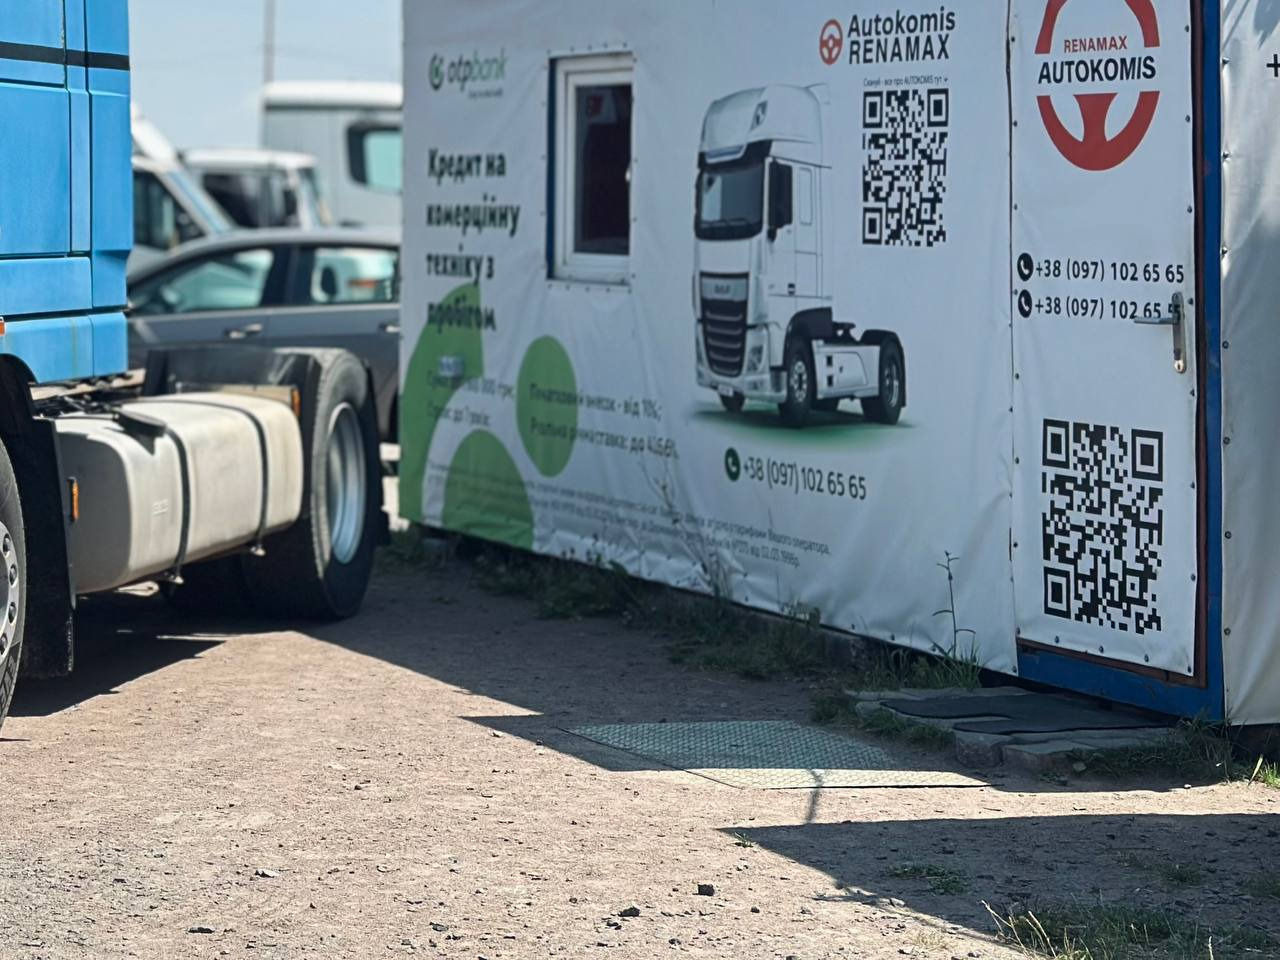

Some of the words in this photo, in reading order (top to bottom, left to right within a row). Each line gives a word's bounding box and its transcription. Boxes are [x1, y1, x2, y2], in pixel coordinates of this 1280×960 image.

[847, 5, 956, 38] Autokomis
[849, 34, 950, 64] RENAMAX
[1064, 35, 1127, 53] RENAMAX
[1038, 55, 1156, 84] AUTOKOMIS
[428, 148, 482, 186] Кредит
[486, 154, 506, 177] на
[426, 193, 521, 238] комерційну
[426, 243, 483, 286] техніку
[1035, 259, 1062, 278] +38
[1066, 258, 1105, 282] (097)
[1111, 262, 1138, 281] 102
[1143, 264, 1160, 283] 65
[1165, 264, 1184, 283] 65
[1035, 296, 1062, 315] +38
[1066, 296, 1105, 320] (097)
[1110, 300, 1138, 319] 102
[1143, 302, 1161, 318] 65
[744, 456, 764, 481] +38
[767, 457, 799, 496] (097)
[801, 466, 824, 493] 102
[827, 471, 845, 497] 65
[848, 475, 867, 500] 65
